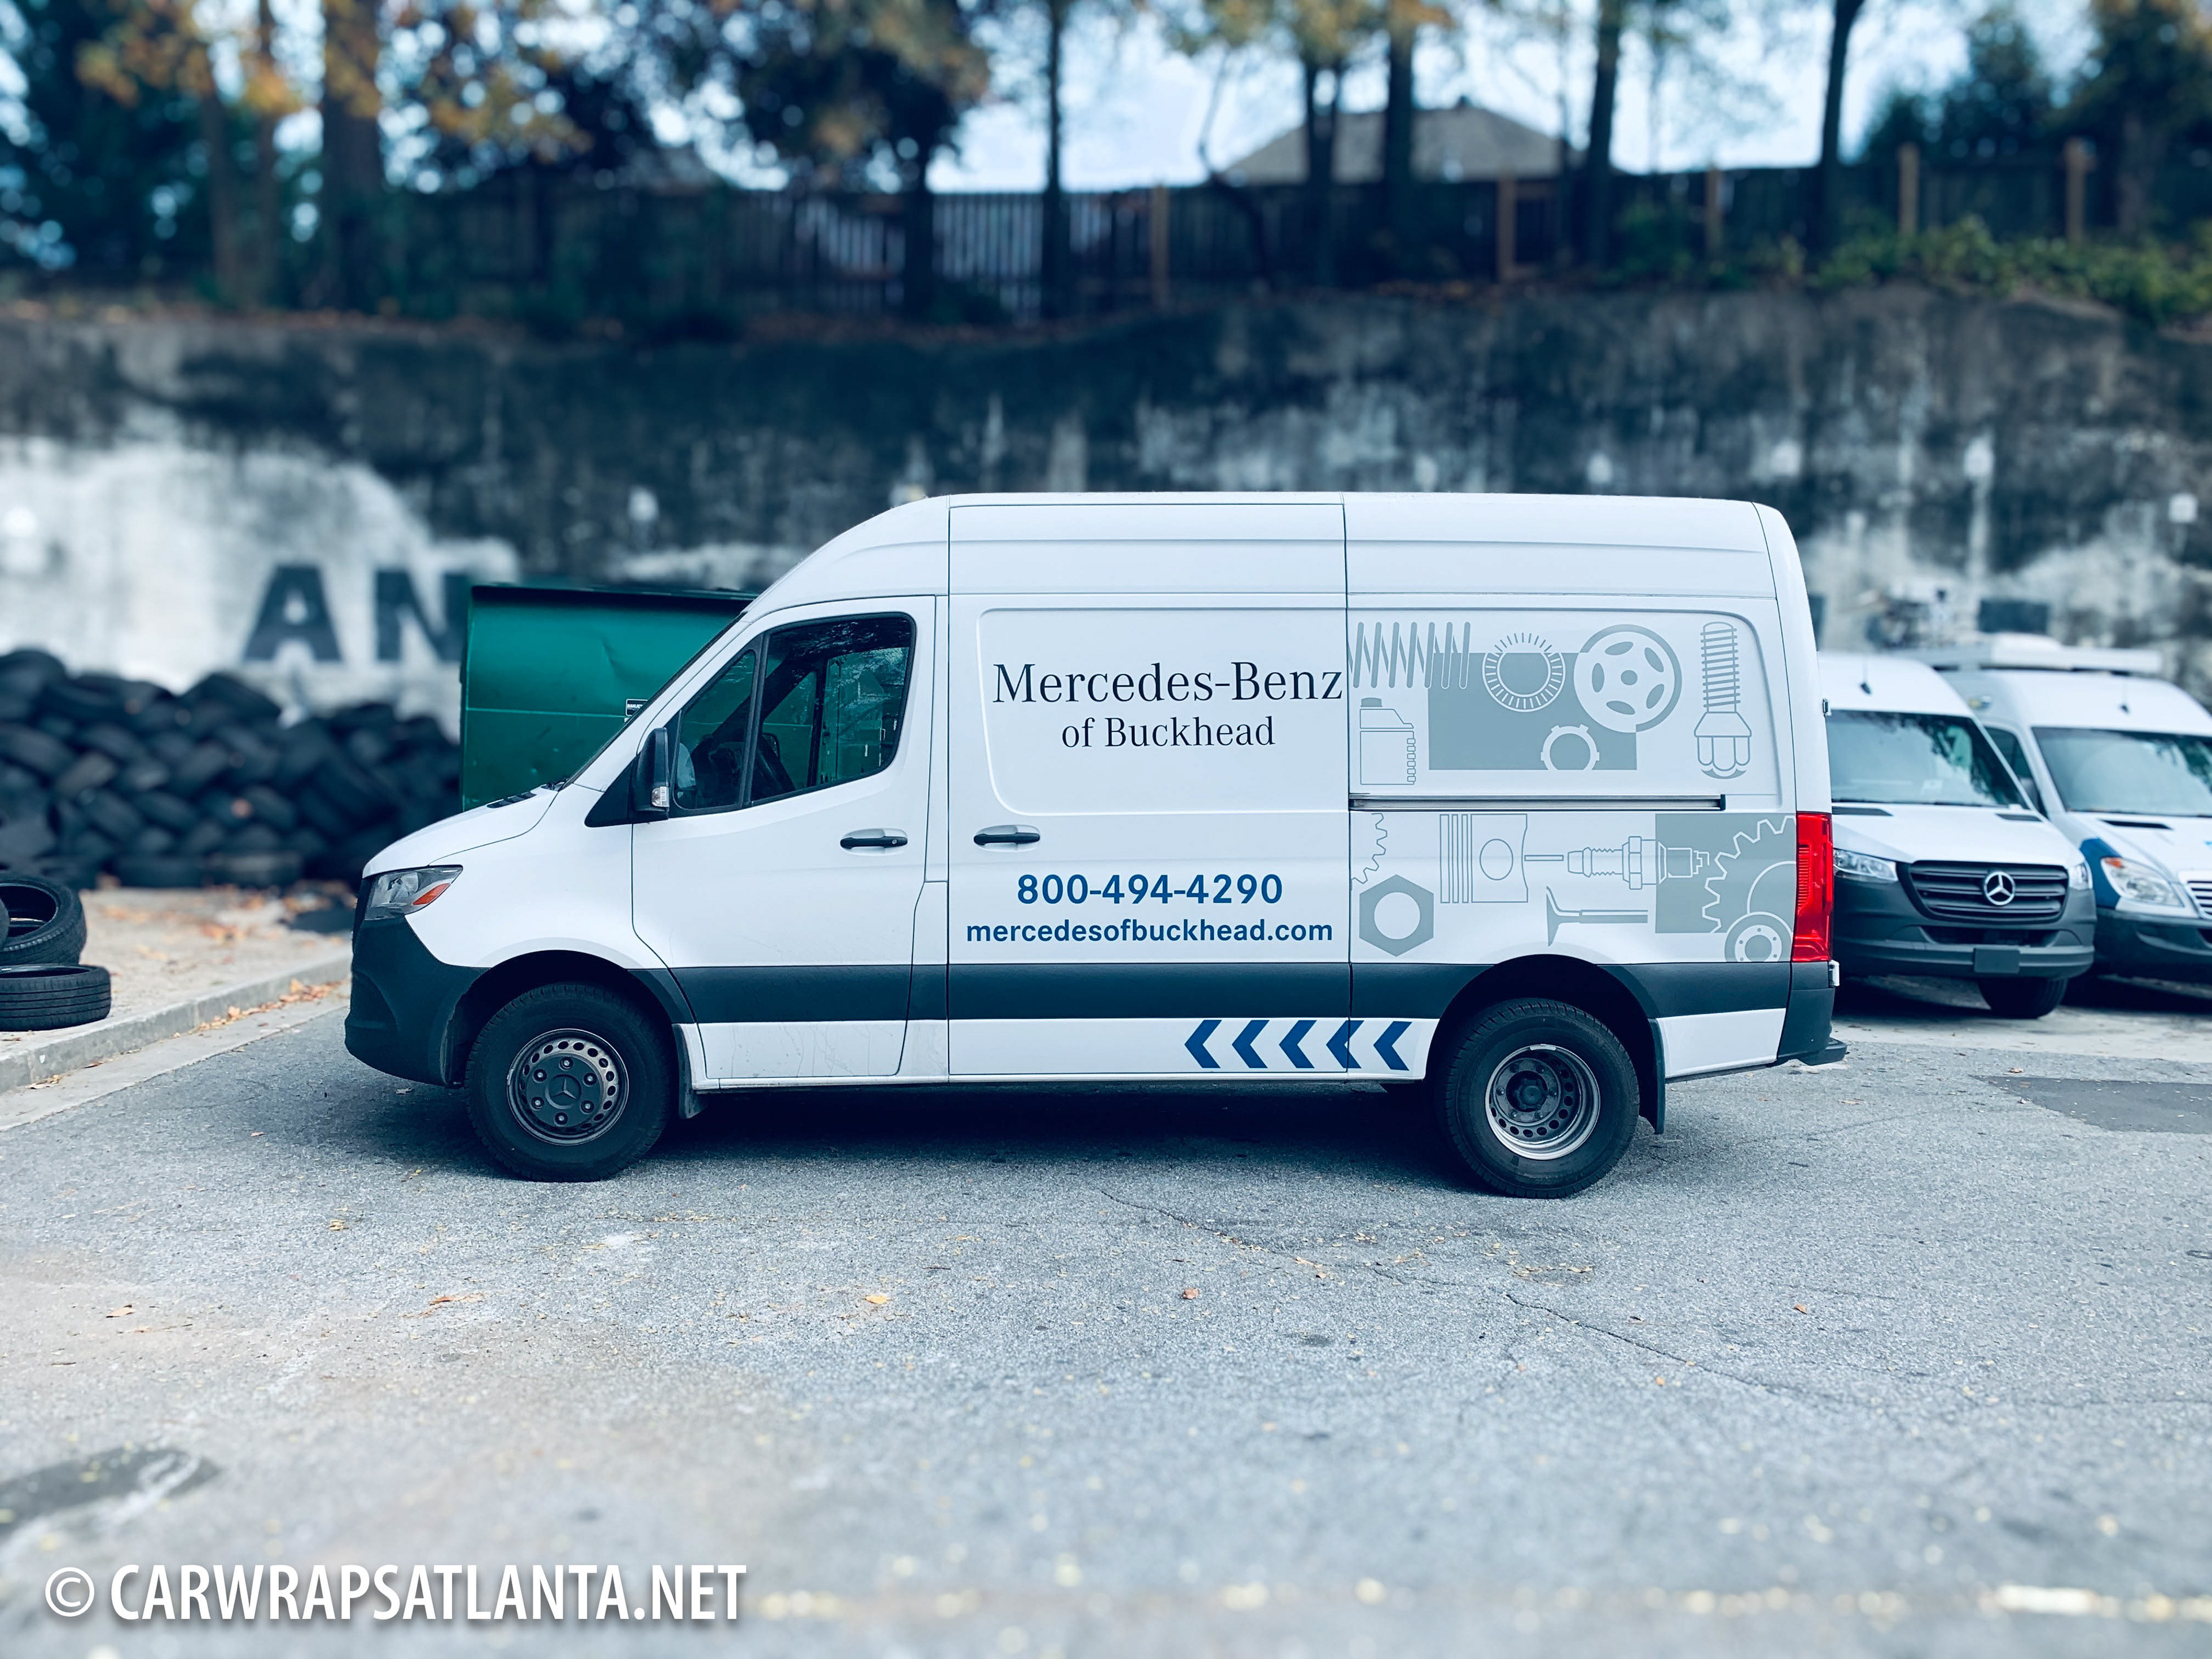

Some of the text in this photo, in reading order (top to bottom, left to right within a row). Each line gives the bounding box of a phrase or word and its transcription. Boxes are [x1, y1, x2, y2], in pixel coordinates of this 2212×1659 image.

[992, 661, 1343, 703] Mercedes-Benz
[1062, 715, 1277, 748] of Buckhead
[1017, 873, 1283, 905] 800-494-4290
[966, 918, 1333, 942] mercedesofbuckhead.com
